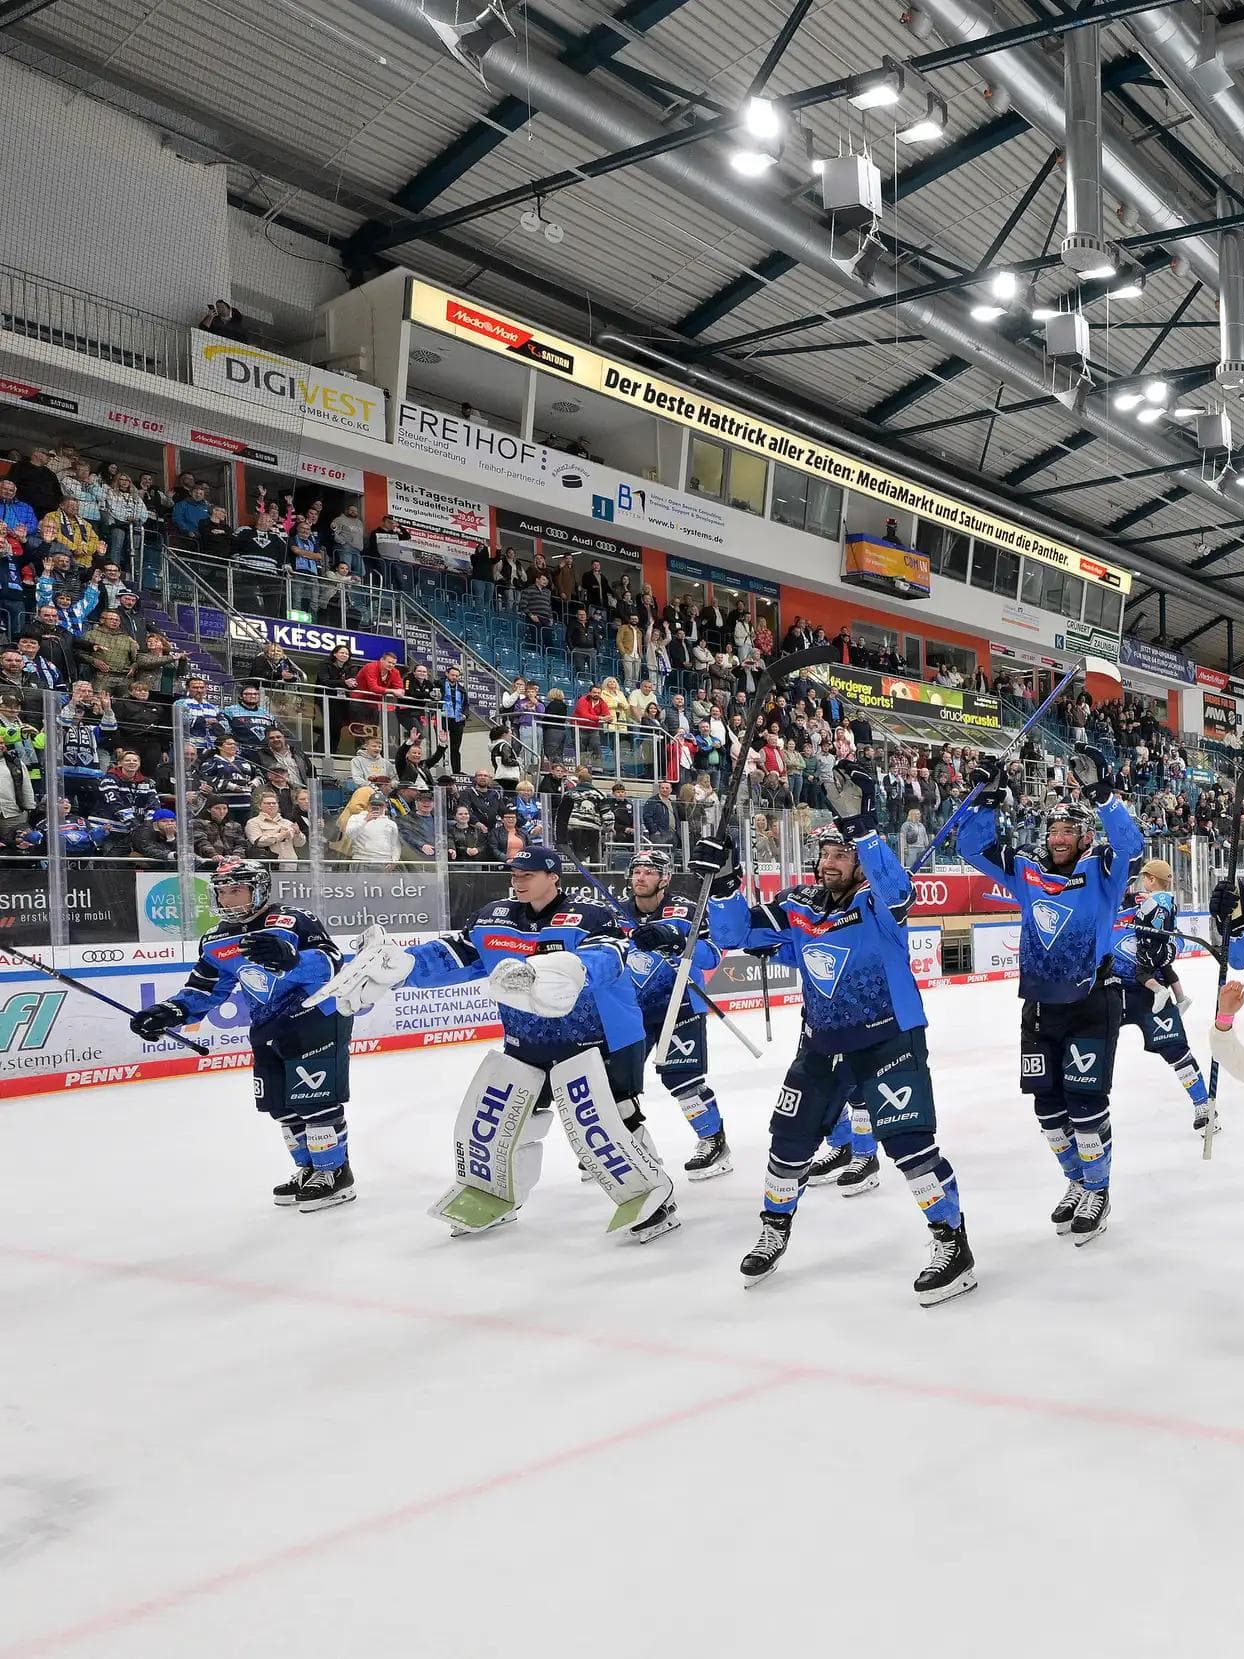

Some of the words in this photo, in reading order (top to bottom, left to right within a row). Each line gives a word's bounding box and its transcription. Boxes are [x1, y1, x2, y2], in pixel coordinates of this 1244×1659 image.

[541, 350, 570, 369] SATURN
[226, 357, 376, 421] DIGIVEST
[108, 411, 139, 427] LET'S
[142, 419, 164, 433] GO!
[331, 414, 339, 423] &
[398, 428, 431, 443] Steuer-
[433, 438, 449, 450] und
[397, 437, 467, 466] Rechtsberatung
[302, 463, 326, 476] LET'S
[328, 469, 345, 480] GO!
[478, 460, 546, 487] freihof-partner.de
[605, 368, 642, 397] Der
[643, 383, 695, 419] beste
[697, 405, 767, 448] Hattrick
[768, 436, 804, 461] aller
[805, 449, 855, 482] Zeiten:
[856, 470, 934, 514] MediaMarkt
[934, 501, 958, 521] und
[959, 511, 995, 537] Saturn
[995, 525, 1015, 545] und
[1016, 532, 1031, 552] die
[1032, 540, 1069, 567] Panther.
[395, 481, 482, 511] Ski-Tagesfahrt
[396, 493, 409, 502] ins
[412, 497, 454, 513] Sudelfeld
[519, 520, 542, 533] Audi
[572, 534, 593, 546] Audi
[619, 547, 639, 559] Audi
[274, 625, 364, 655] KESSEL
[829, 675, 872, 694] förderer
[859, 693, 893, 709] sports!
[364, 881, 383, 897] in
[391, 881, 426, 897] der
[0, 889, 92, 910] smädtl
[85, 910, 111, 922] mobil
[133, 948, 175, 960] Audi
[395, 986, 481, 1002] FUNKTECHNIK
[395, 998, 497, 1016] SCHALTANLAGEN
[396, 1016, 449, 1031] FACILITY
[1153, 1032, 1179, 1042] BAUER
[302, 1042, 335, 1060] BAUER
[198, 1053, 253, 1071] PENN
[876, 1051, 912, 1078] BAUER
[1023, 1057, 1042, 1075] DB
[1064, 1073, 1098, 1083] BAUER
[290, 1091, 331, 1100] BAUER
[502, 1087, 530, 1142] VORAUS
[877, 1112, 919, 1127] BAUER
[469, 1082, 514, 1183] BÜCHL
[553, 1087, 569, 1119] EINE
[564, 1119, 581, 1148] IDEE
[576, 1146, 616, 1192] VORAUS
[566, 1075, 627, 1186] BÜCHL
[458, 1141, 466, 1178] BAUER
